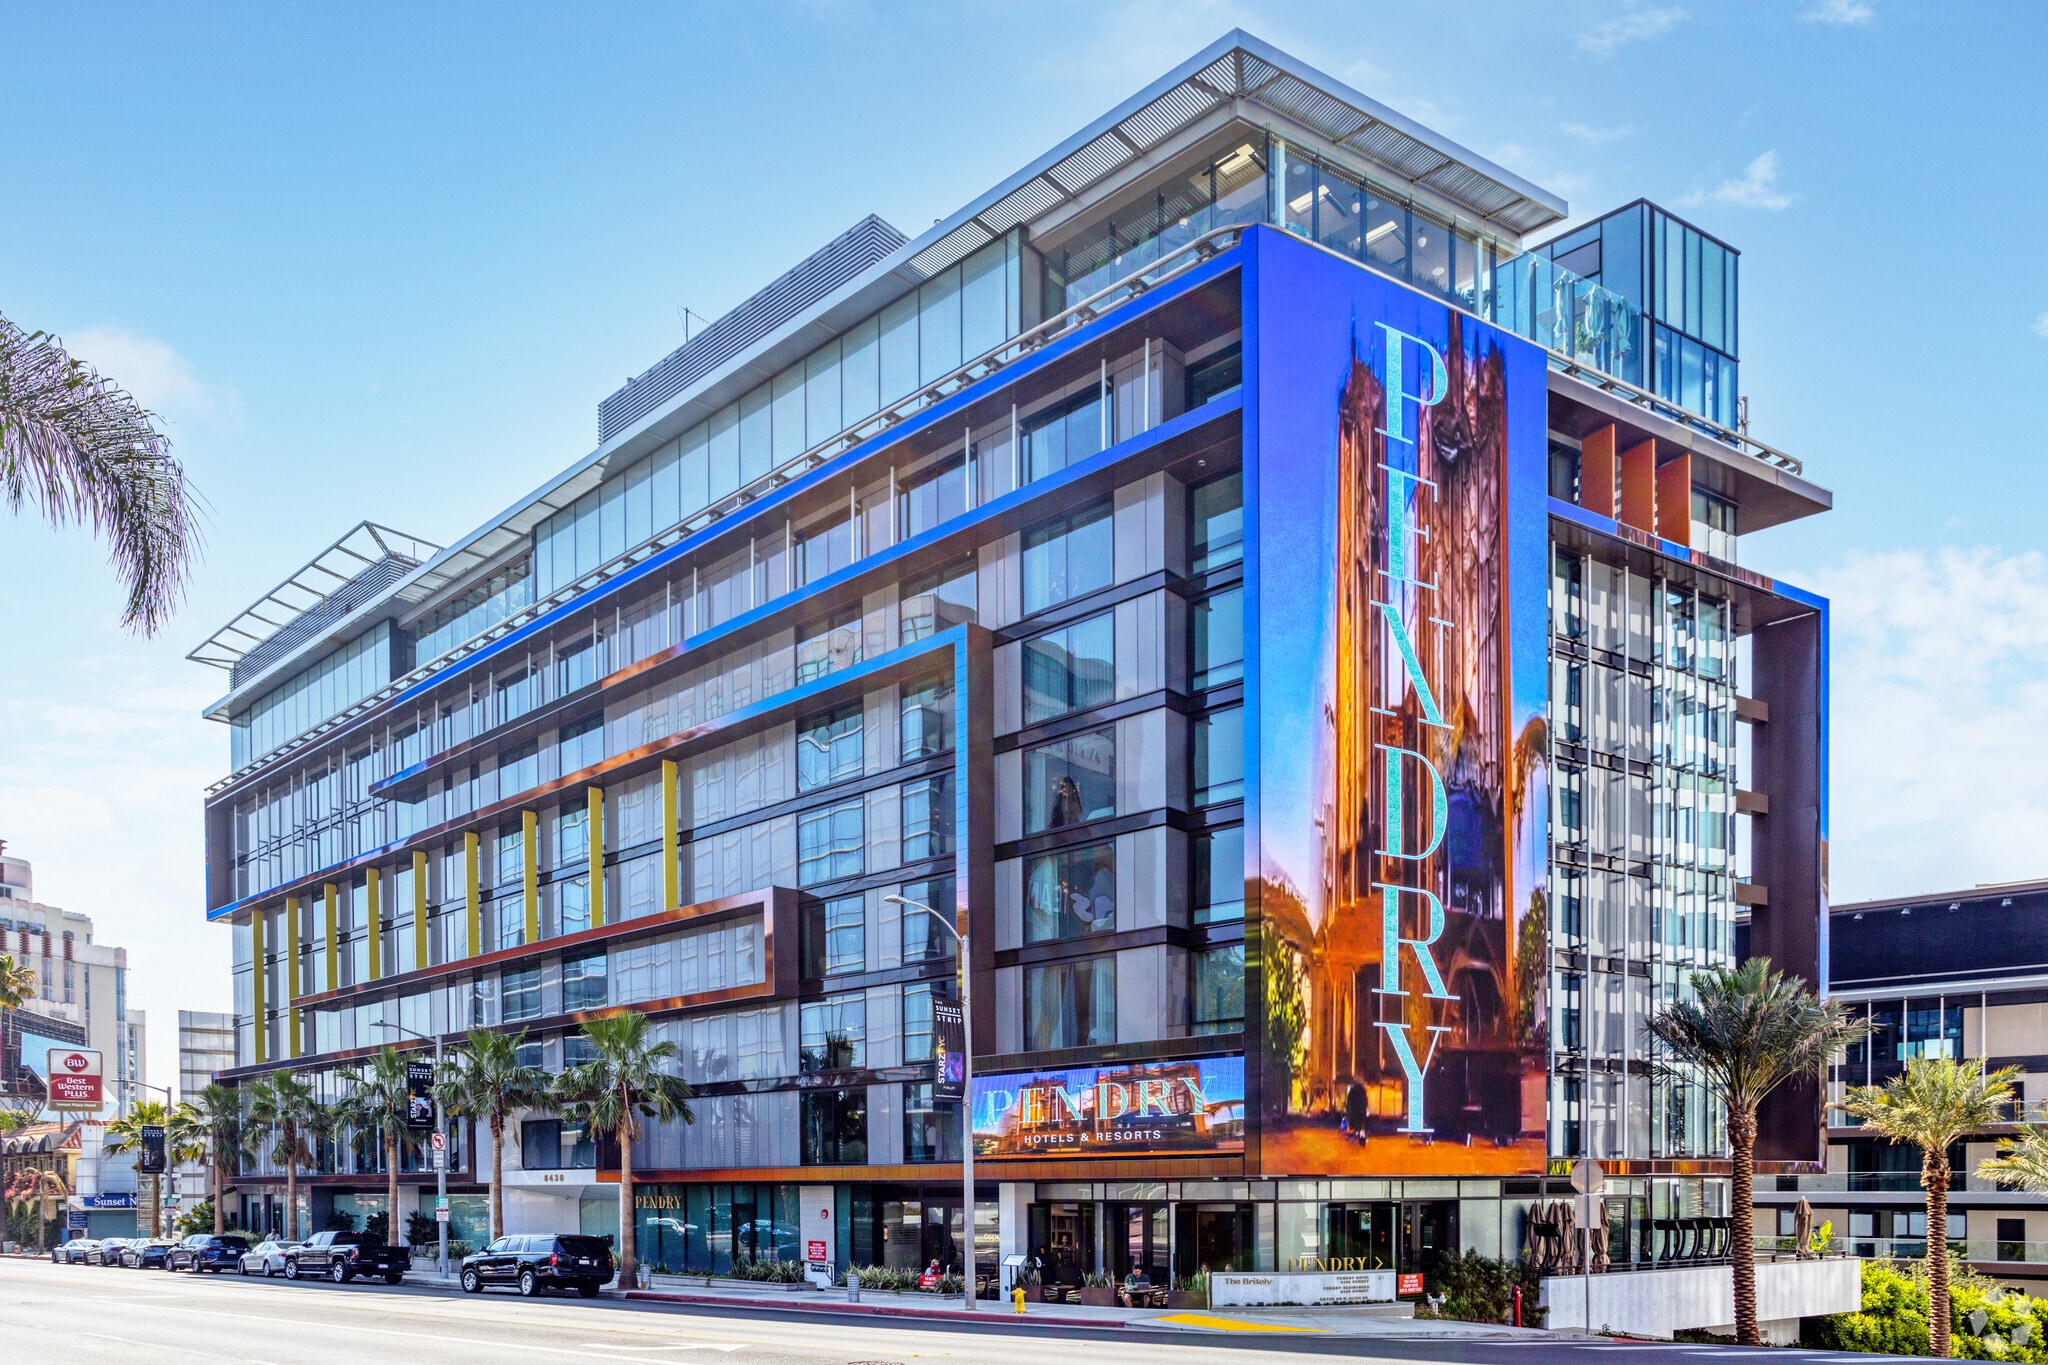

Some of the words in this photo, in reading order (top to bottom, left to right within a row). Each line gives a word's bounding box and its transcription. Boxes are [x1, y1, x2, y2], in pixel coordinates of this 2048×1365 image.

[1370, 320, 1461, 1133] PENDRY
[935, 1005, 961, 1014] SUNSET
[936, 1015, 962, 1025] STRIP
[66, 1058, 85, 1068] BW
[938, 1054, 946, 1084] STARZ
[66, 1076, 87, 1084] Best
[57, 1082, 95, 1091] Western
[982, 1075, 1217, 1127] PENDRY
[1024, 1134, 1075, 1144] HOTELS
[1080, 1133, 1090, 1142] &
[1096, 1130, 1162, 1142] RESORTS
[94, 1197, 125, 1206] Sunset
[635, 1195, 682, 1209] PENDRY
[1288, 1256, 1368, 1272] PENDRY
[1242, 1278, 1272, 1286] Britely
